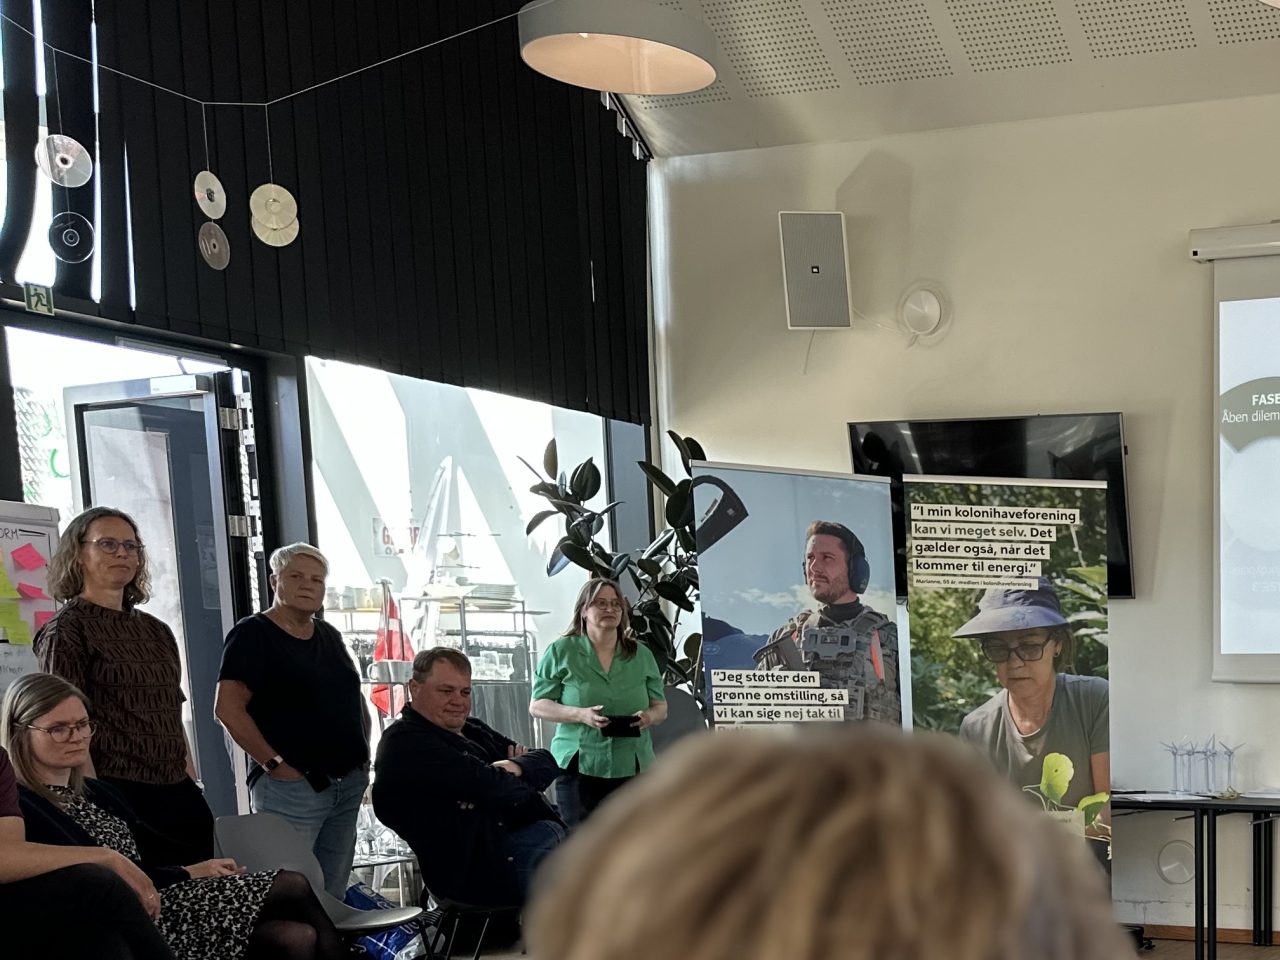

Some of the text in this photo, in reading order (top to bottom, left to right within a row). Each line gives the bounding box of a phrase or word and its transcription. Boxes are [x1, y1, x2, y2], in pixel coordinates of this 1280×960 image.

[1221, 410, 1249, 424] Åben
[927, 507, 951, 517] min
[955, 507, 1076, 523] kolonihaveforening
[914, 524, 1053, 539] kan vi meget selv. Det
[915, 542, 1046, 557] gælder også, når det
[915, 559, 969, 571] kommer
[972, 560, 985, 572] til
[745, 672, 790, 683] støtter
[792, 673, 816, 683] den
[715, 690, 844, 703] grønne omstilling, så
[716, 708, 841, 720] vi kan sige nej tak til
